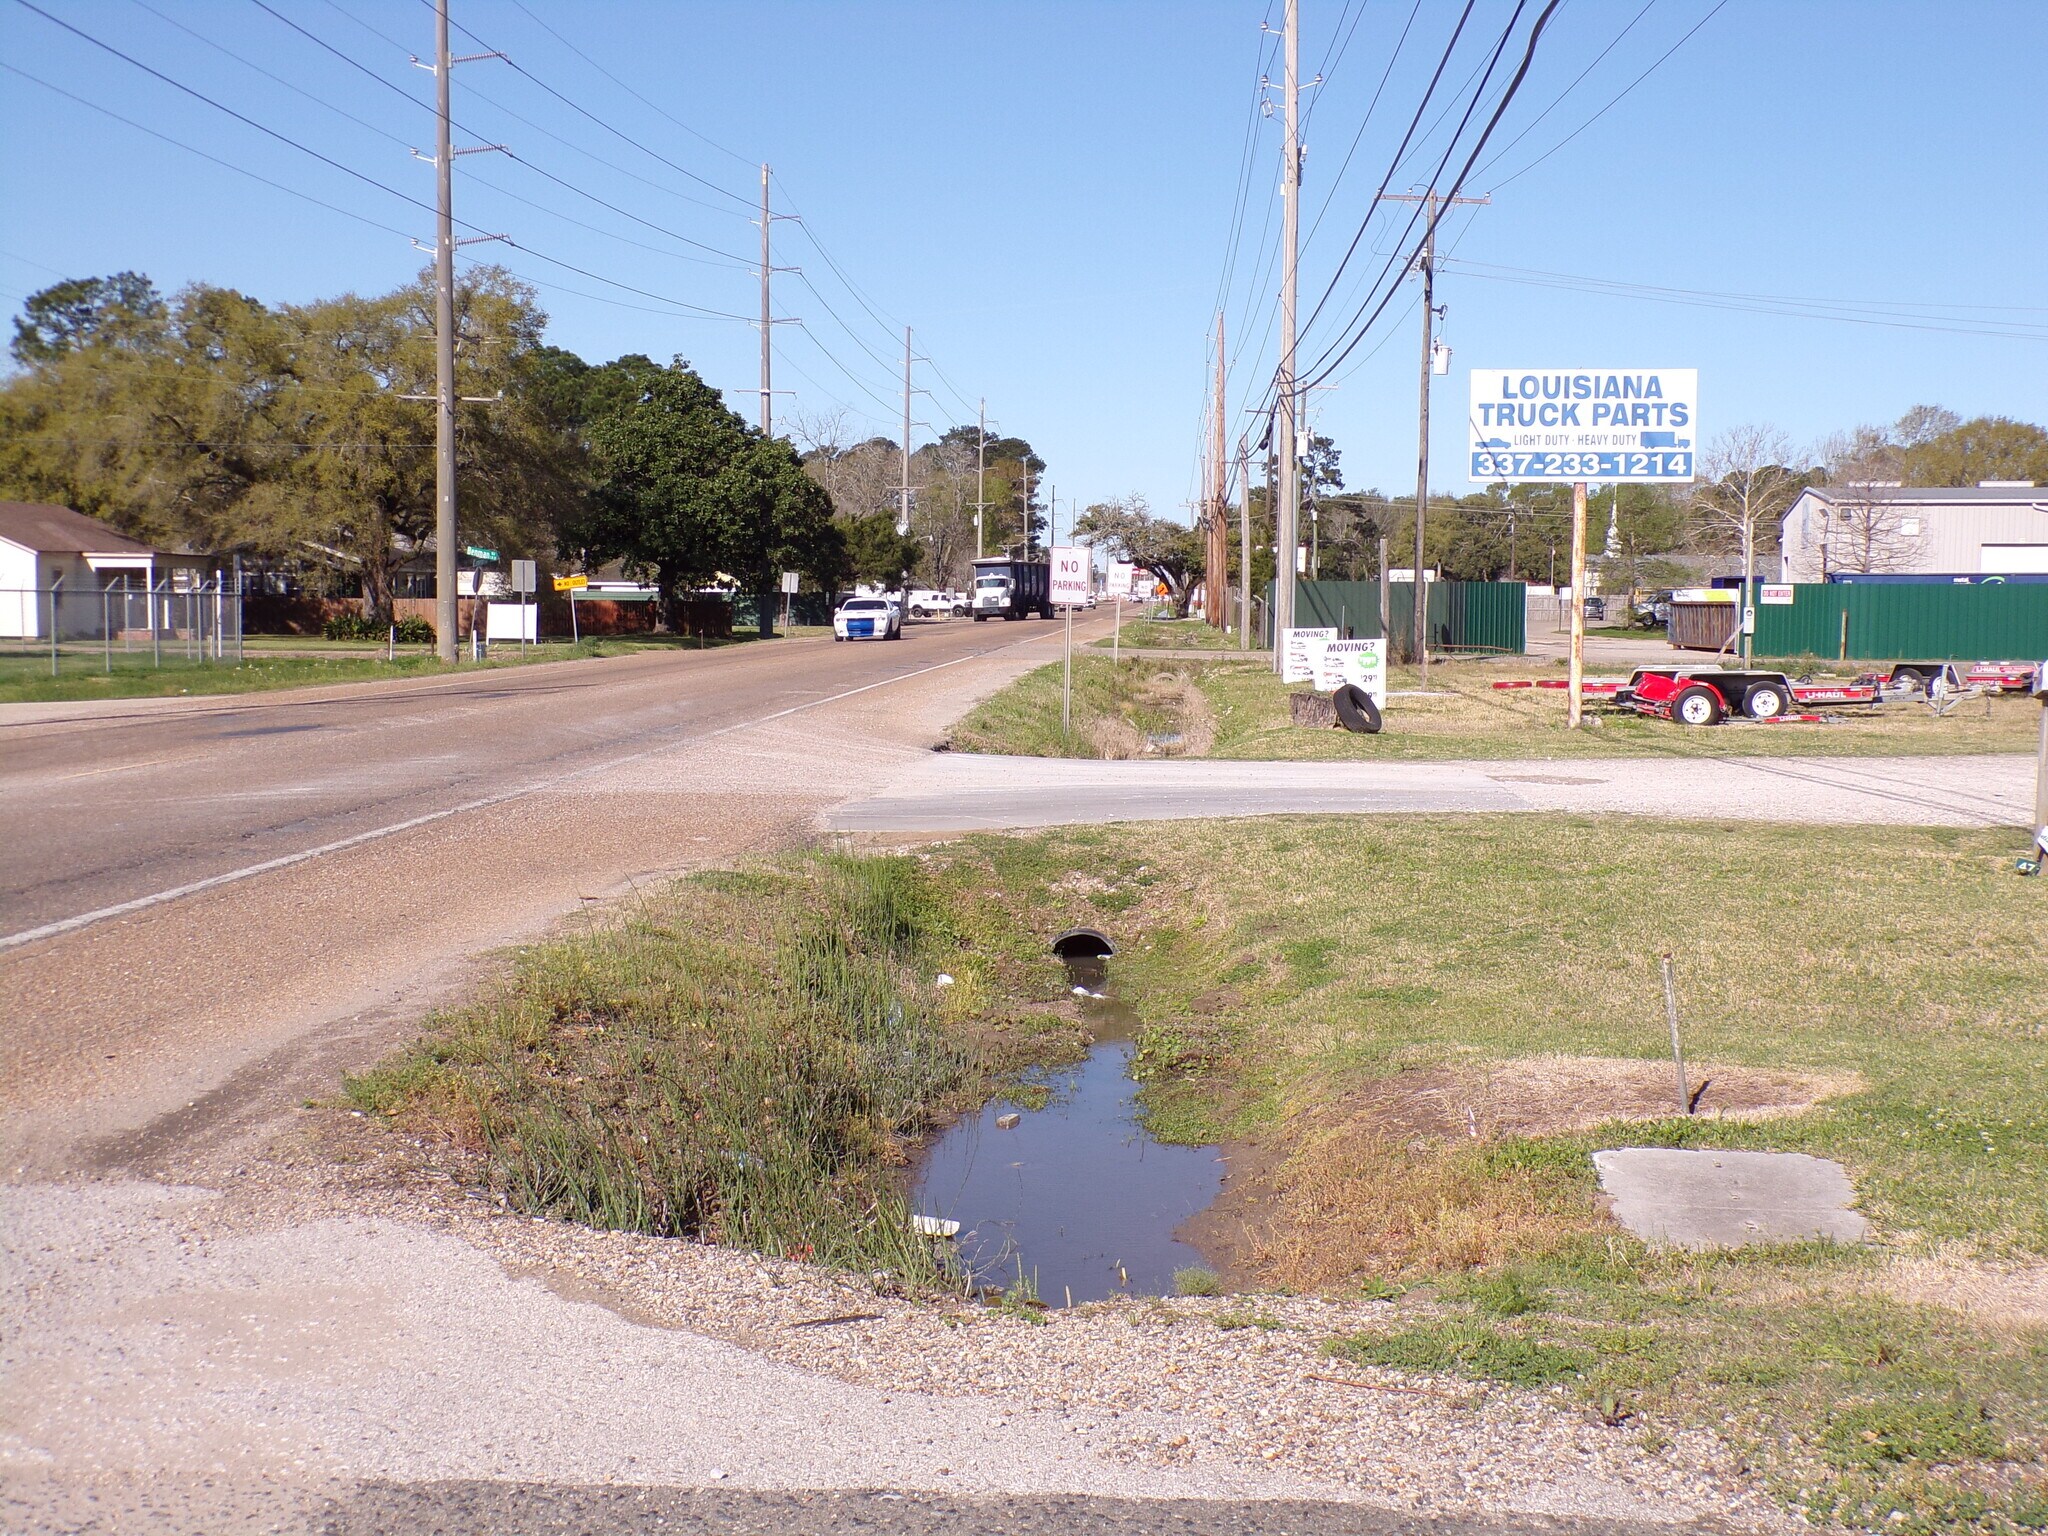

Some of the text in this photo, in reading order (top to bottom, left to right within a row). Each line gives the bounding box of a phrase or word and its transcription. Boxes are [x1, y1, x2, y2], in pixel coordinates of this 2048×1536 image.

[1502, 375, 1663, 400] LOUISIANA
[1478, 402, 1689, 427] TRUCK PARTS
[1514, 434, 1637, 446] LIGHT DUTY HEAVY DUTY
[1477, 453, 1687, 475] 337-233-1214
[1060, 560, 1078, 573] NO
[1053, 580, 1086, 592] PARKING
[1293, 630, 1330, 638] MOVING?
[1326, 642, 1375, 653] MOVING?
